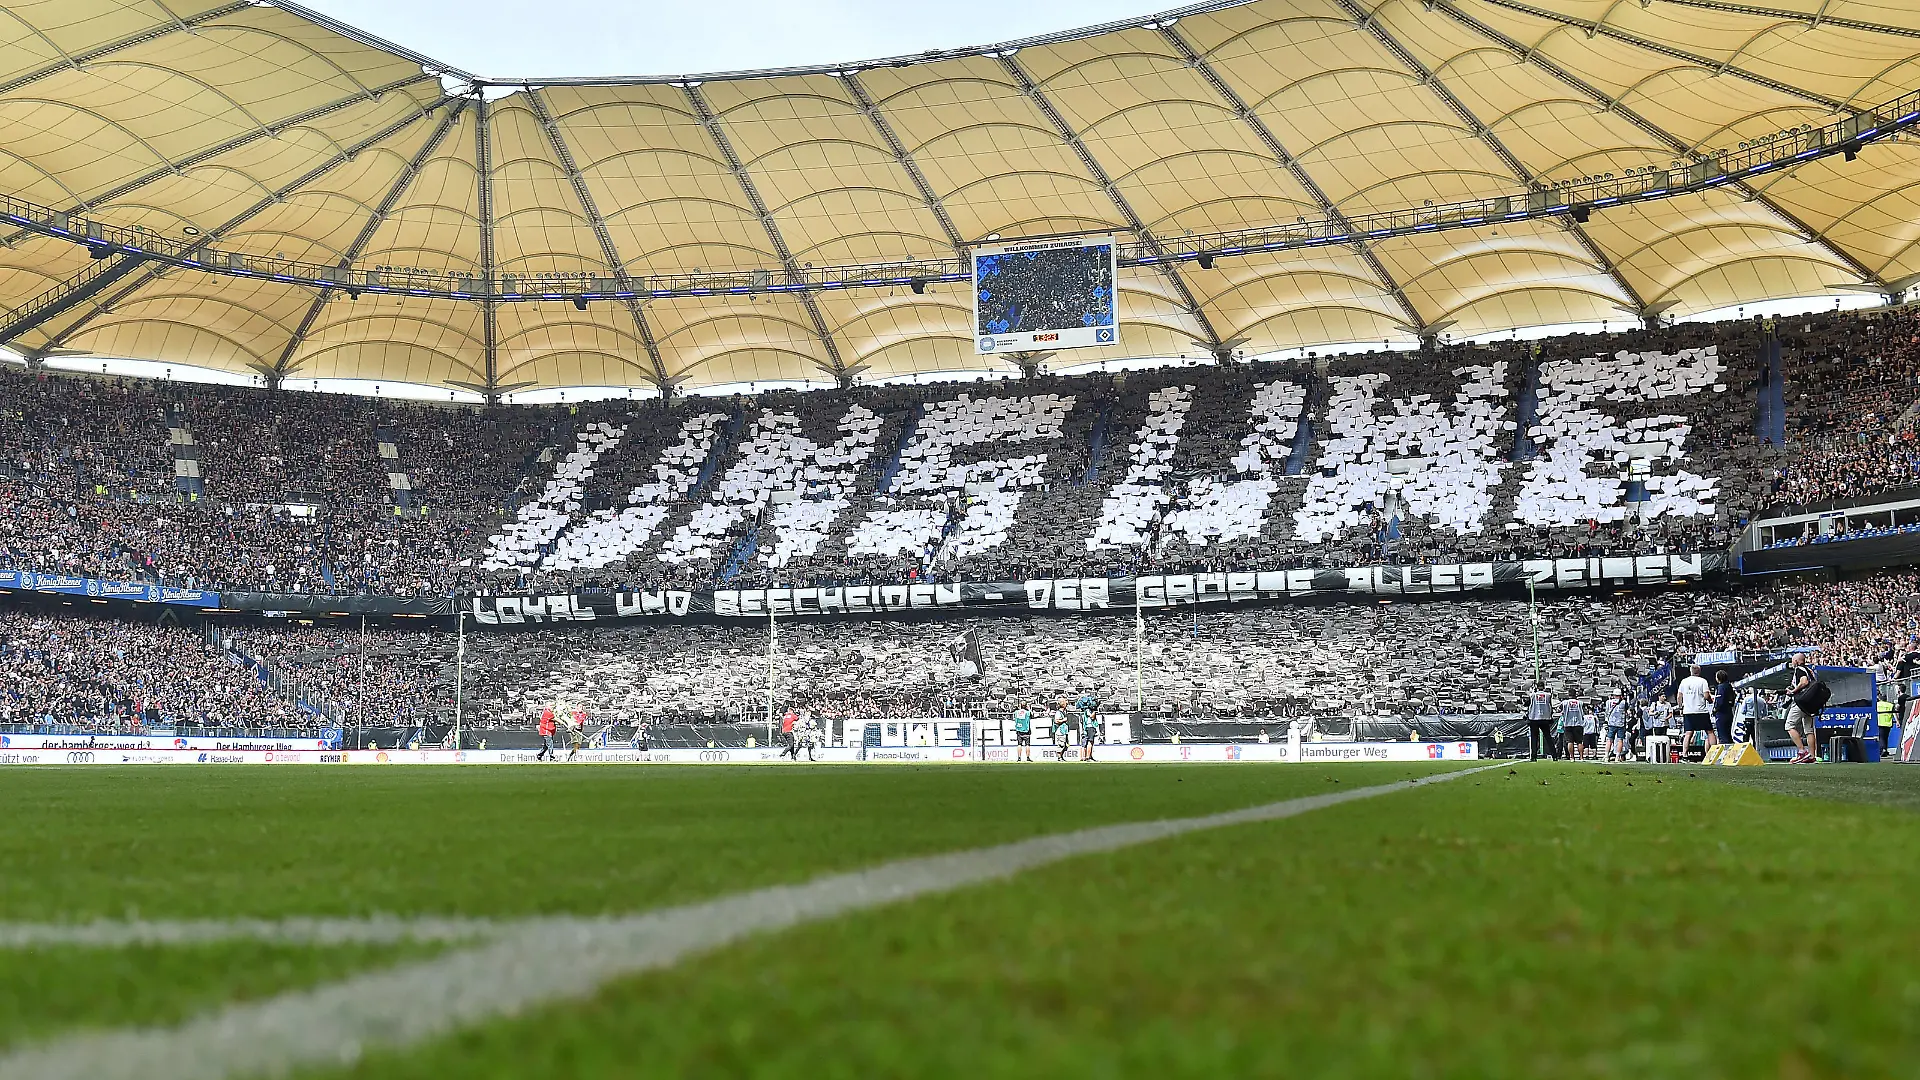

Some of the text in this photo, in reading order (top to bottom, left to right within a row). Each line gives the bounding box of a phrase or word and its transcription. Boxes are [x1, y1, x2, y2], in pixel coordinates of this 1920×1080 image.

[1085, 345, 1726, 552] UWE
[473, 594, 596, 625] LOYAL
[616, 590, 692, 616] UND
[714, 583, 964, 617] BESCHEIDEN
[1024, 578, 1110, 610] DER
[1345, 563, 1494, 594] ALLER
[1522, 553, 1703, 590] ZEITEN
[216, 742, 230, 750] Der
[232, 742, 274, 750] Hamburger
[500, 753, 515, 762] Der
[517, 753, 563, 763] Hamurer
[586, 752, 603, 762] wird
[873, 751, 920, 760] Hapag-Lloyd
[1042, 750, 1079, 758] REYER
[1301, 747, 1388, 759] Hamburger Weg
